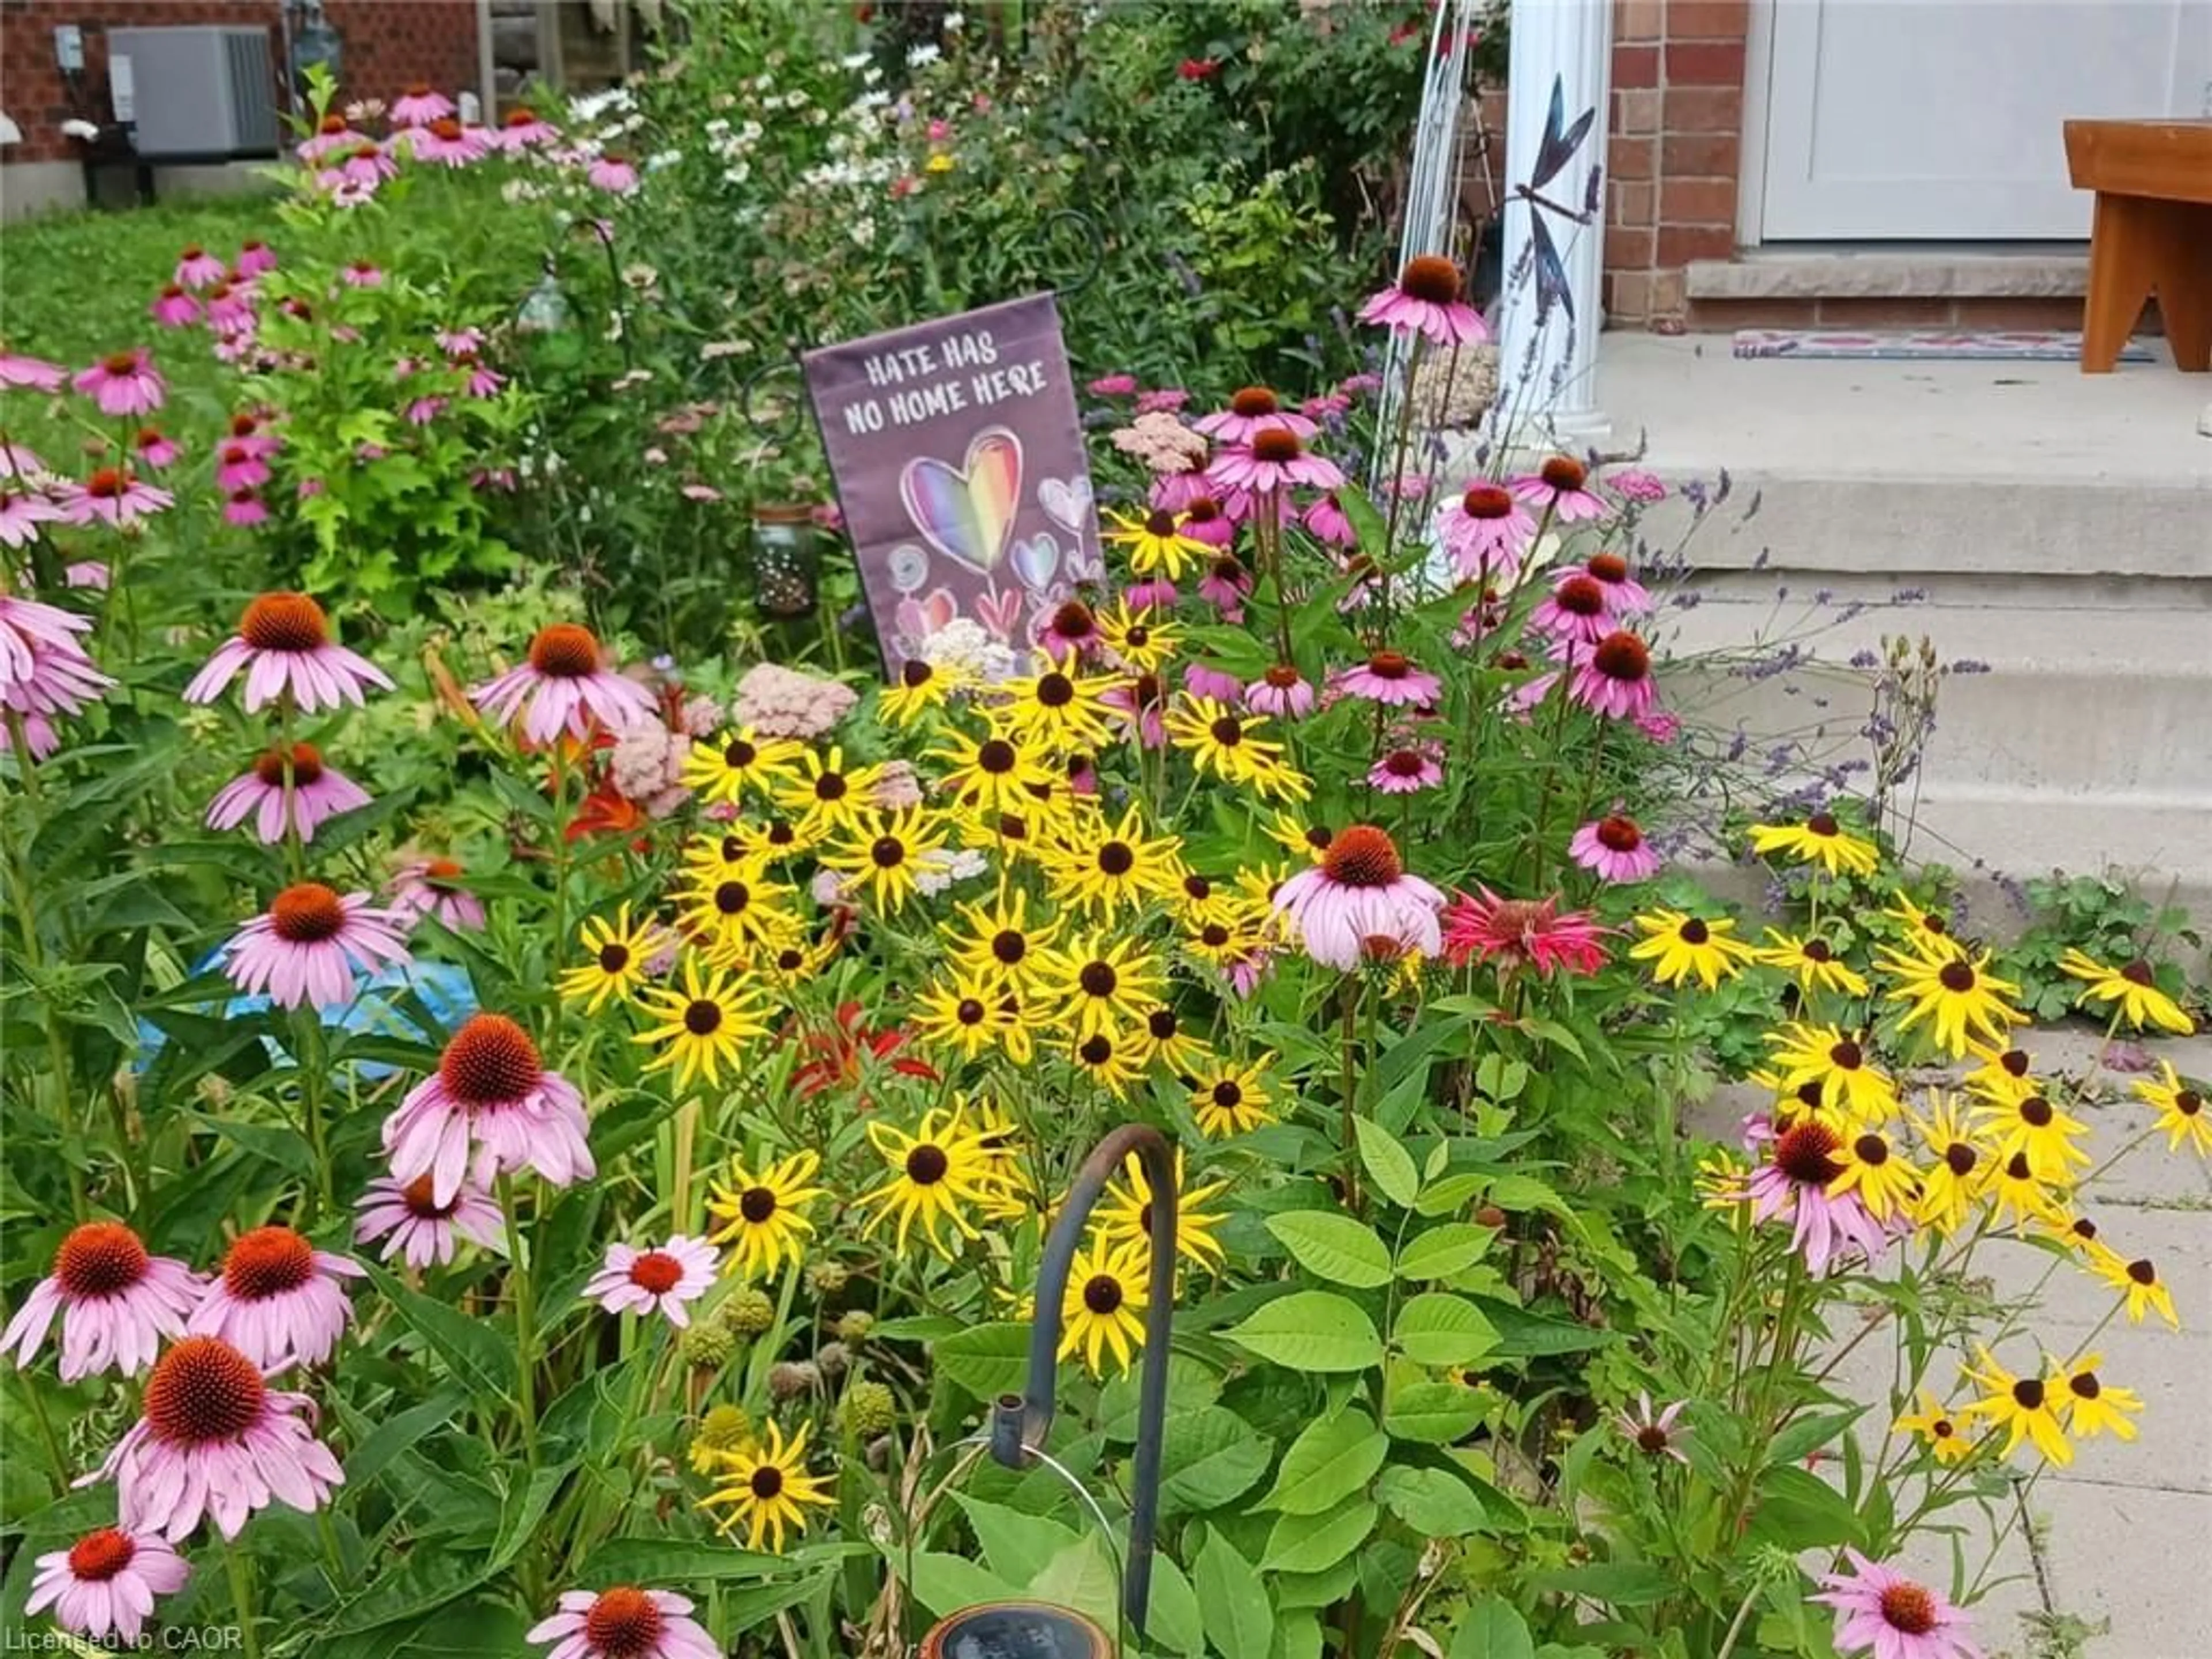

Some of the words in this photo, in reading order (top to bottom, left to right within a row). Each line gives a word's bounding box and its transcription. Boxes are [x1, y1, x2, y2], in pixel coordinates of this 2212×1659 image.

[865, 345, 937, 386] HATE
[941, 331, 998, 366] HAS
[844, 400, 884, 433] NO
[889, 380, 967, 425] HOME
[973, 361, 1046, 403] HERE
